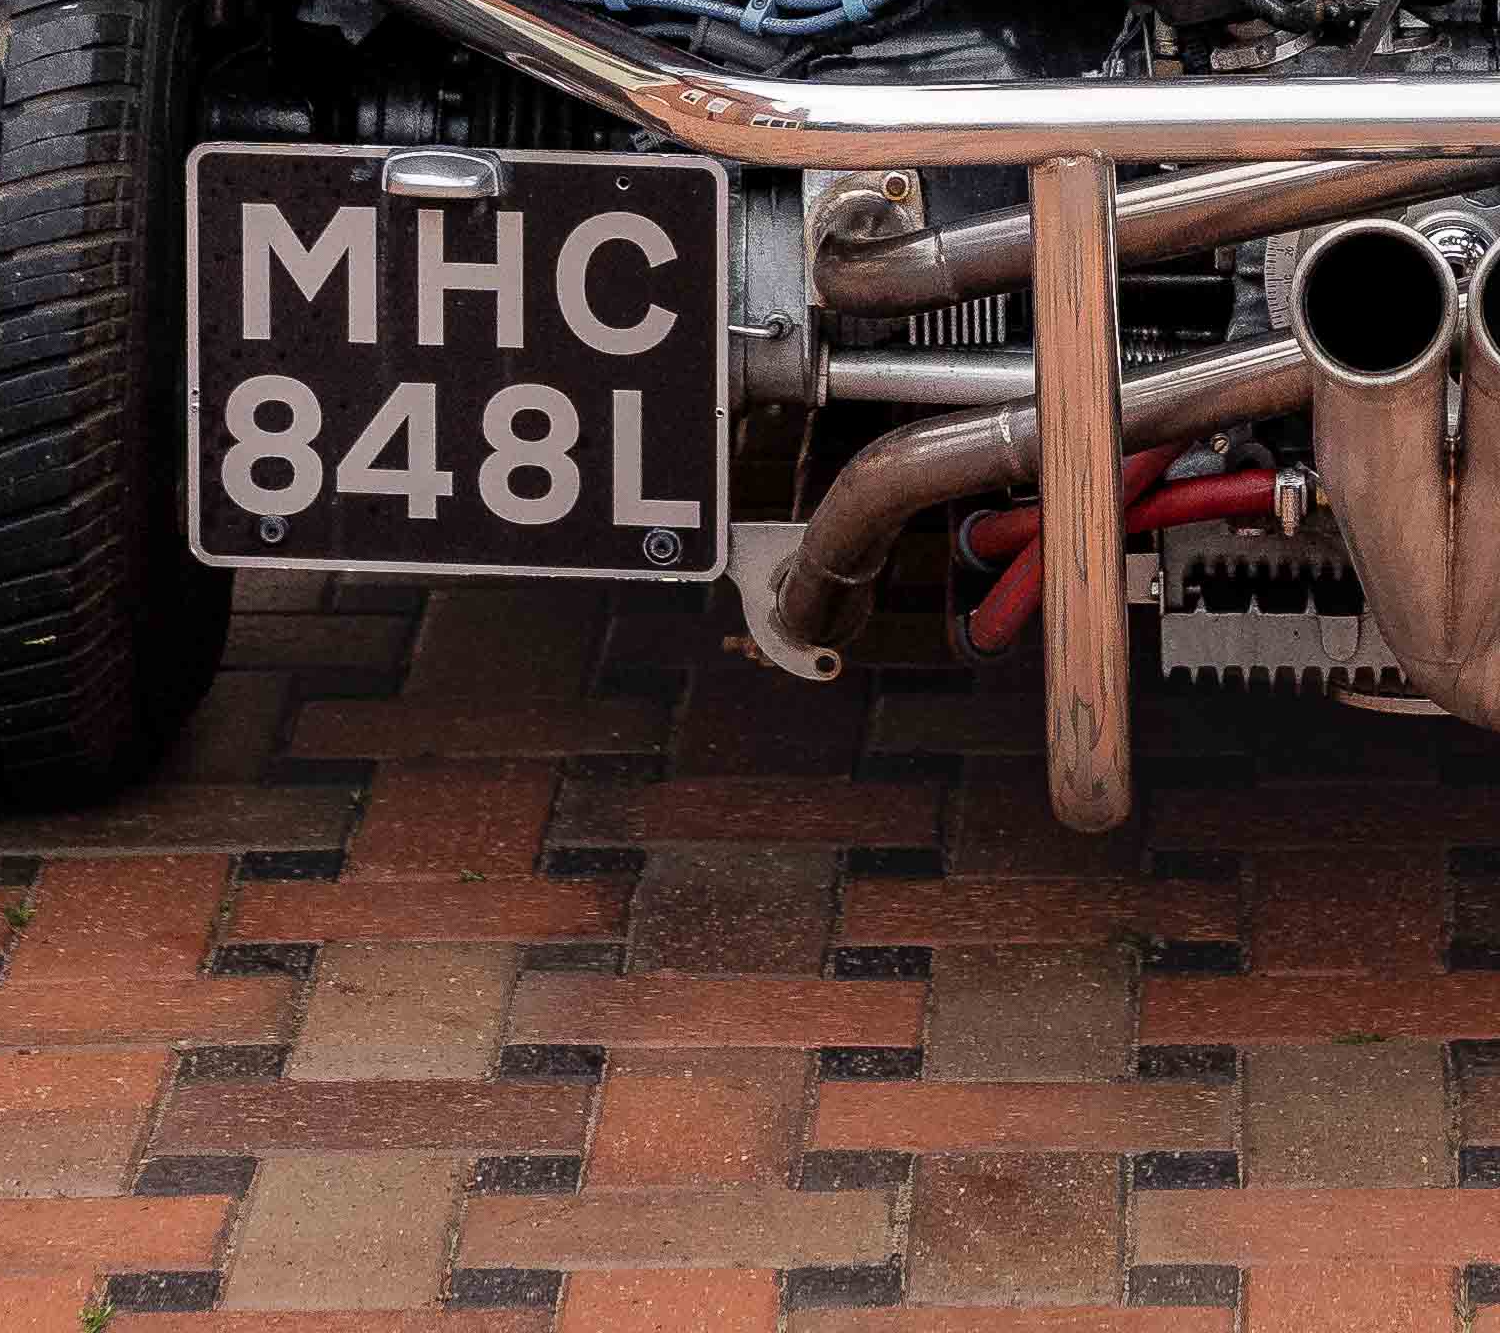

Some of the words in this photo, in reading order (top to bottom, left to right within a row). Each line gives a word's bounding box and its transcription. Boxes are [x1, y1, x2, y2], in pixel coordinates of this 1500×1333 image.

[723, 6, 743, 17] WIR
[242, 202, 678, 355] MHC
[222, 374, 700, 528] 848L
